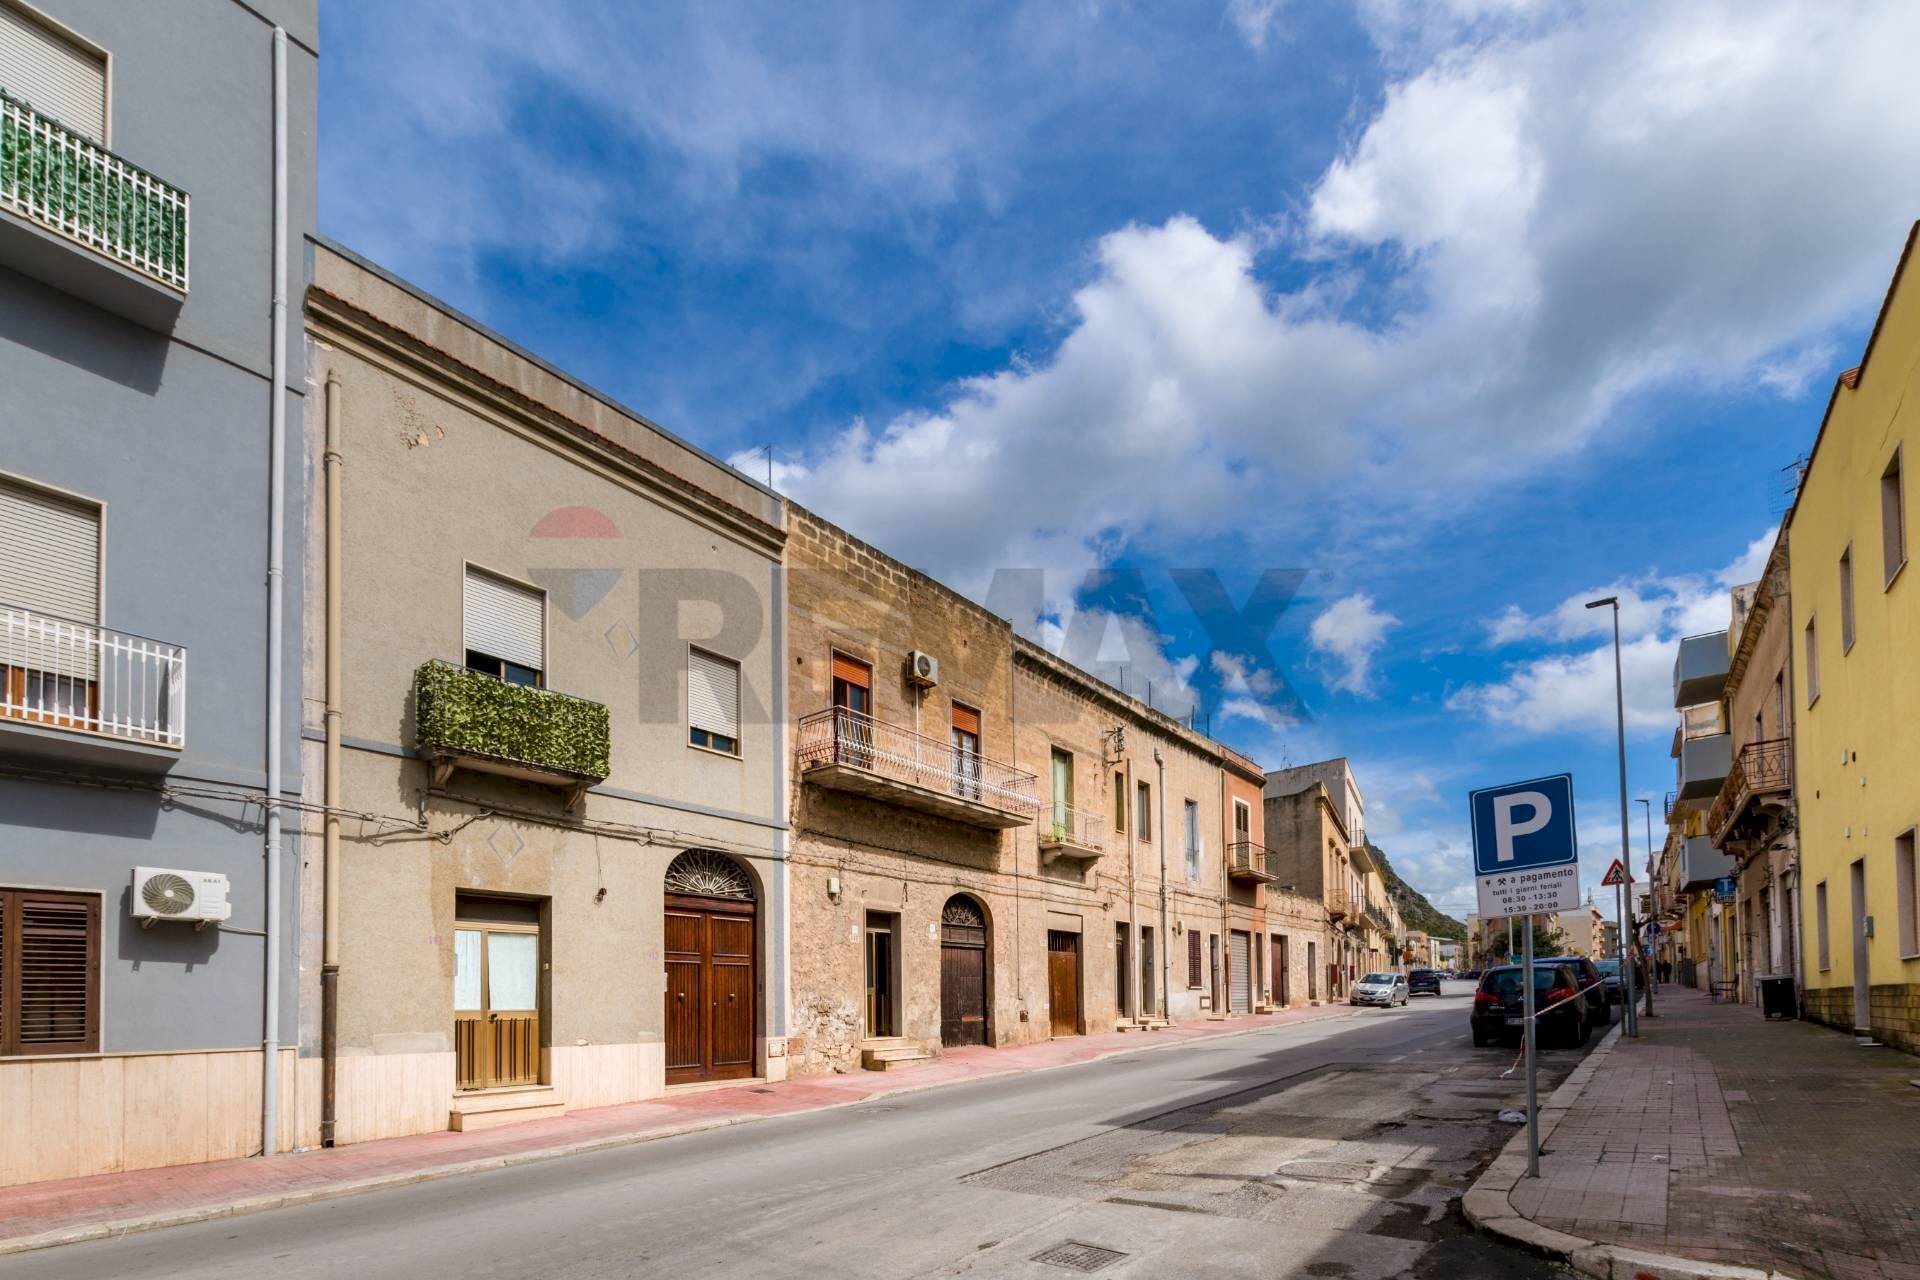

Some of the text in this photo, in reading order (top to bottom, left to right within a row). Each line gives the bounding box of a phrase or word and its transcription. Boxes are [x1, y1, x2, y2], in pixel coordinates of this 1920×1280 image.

[1493, 791, 1552, 862] P
[1510, 869, 1574, 884] a pagamento
[1492, 888, 1507, 896] tutti
[1516, 885, 1537, 895] giorni
[1540, 881, 1562, 890] feriali
[1720, 879, 1732, 891] T
